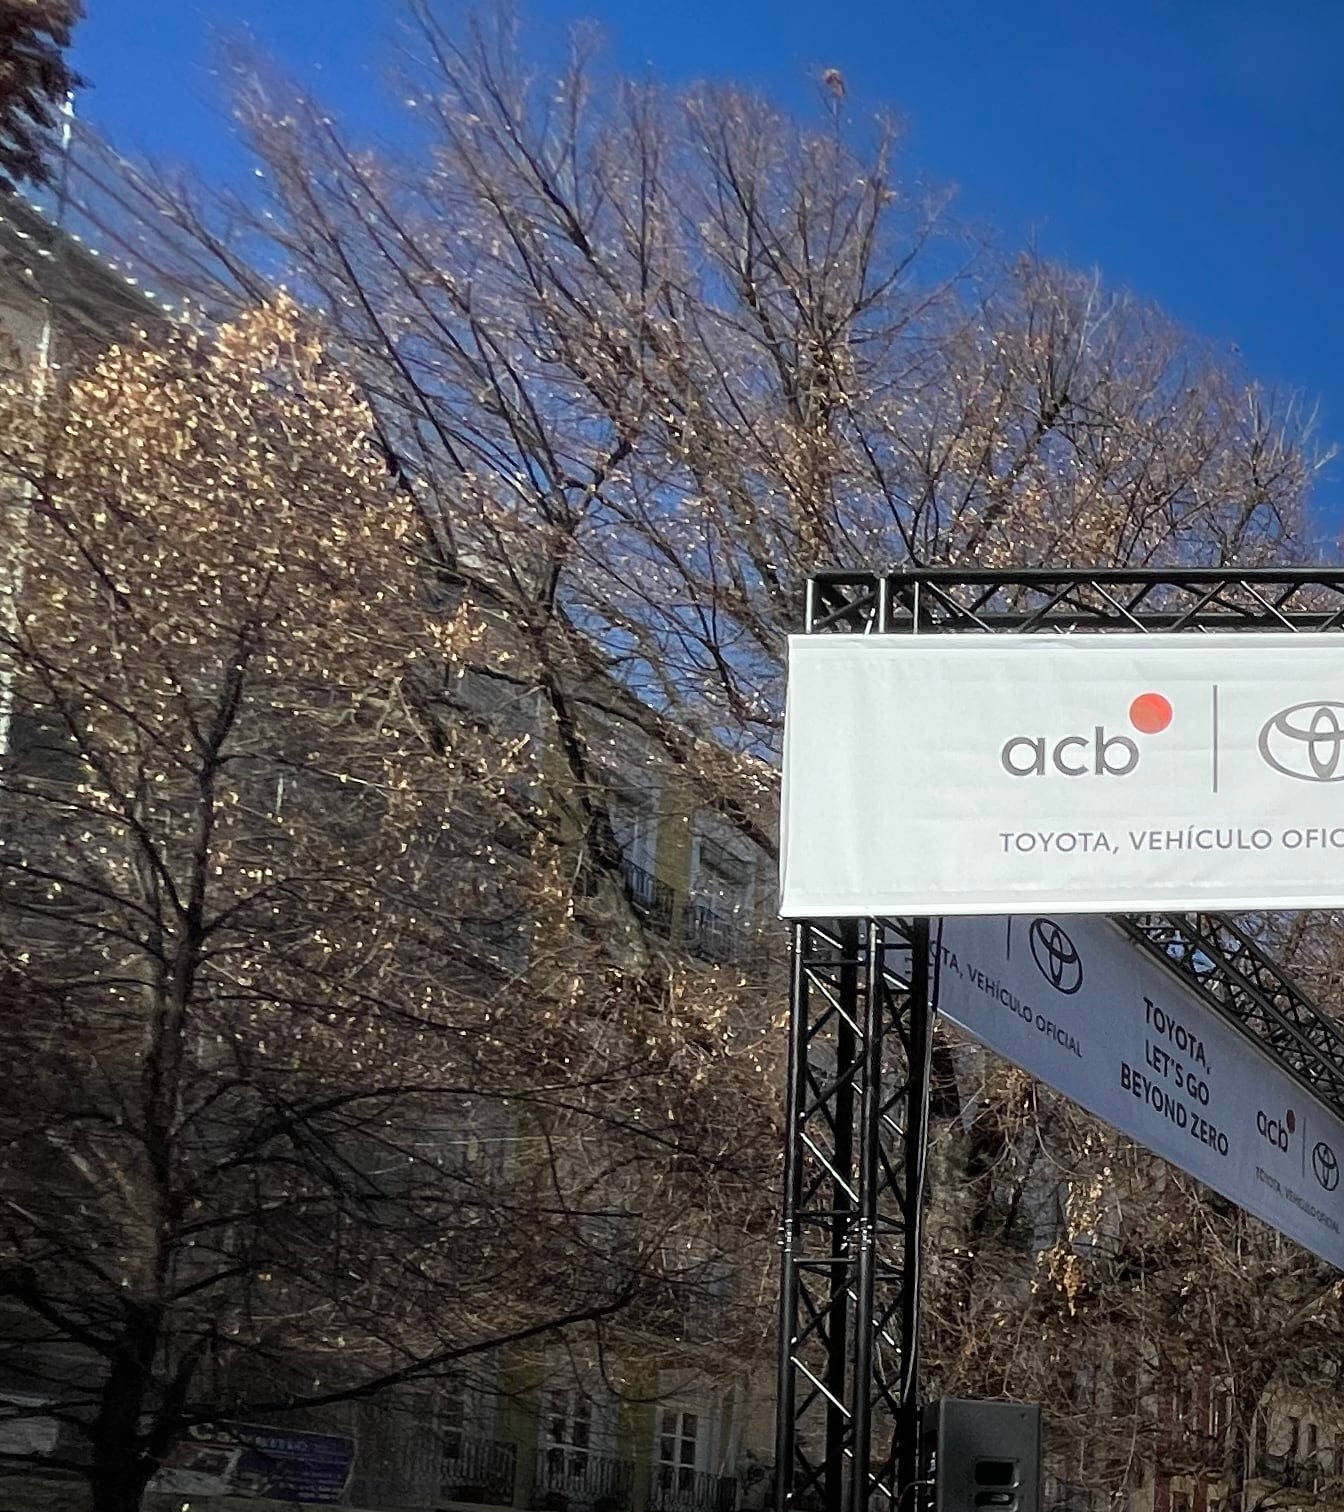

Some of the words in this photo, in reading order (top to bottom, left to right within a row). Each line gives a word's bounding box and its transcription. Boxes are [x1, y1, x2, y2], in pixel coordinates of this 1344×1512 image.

[1000, 721, 1139, 779] acb
[1000, 832, 1120, 856] TOYOTA,
[1128, 824, 1274, 851] VEHÍCULO
[966, 963, 1033, 1023] VEHÍCULO
[1036, 1015, 1083, 1058] OFICIAL
[1143, 996, 1211, 1076] TOYOTA,
[1145, 1039, 1184, 1088] LET'S
[1186, 1072, 1210, 1106] GO
[1120, 1061, 1187, 1129] BEYOND
[1191, 1111, 1229, 1157] ZERO
[1256, 1109, 1289, 1153] acb
